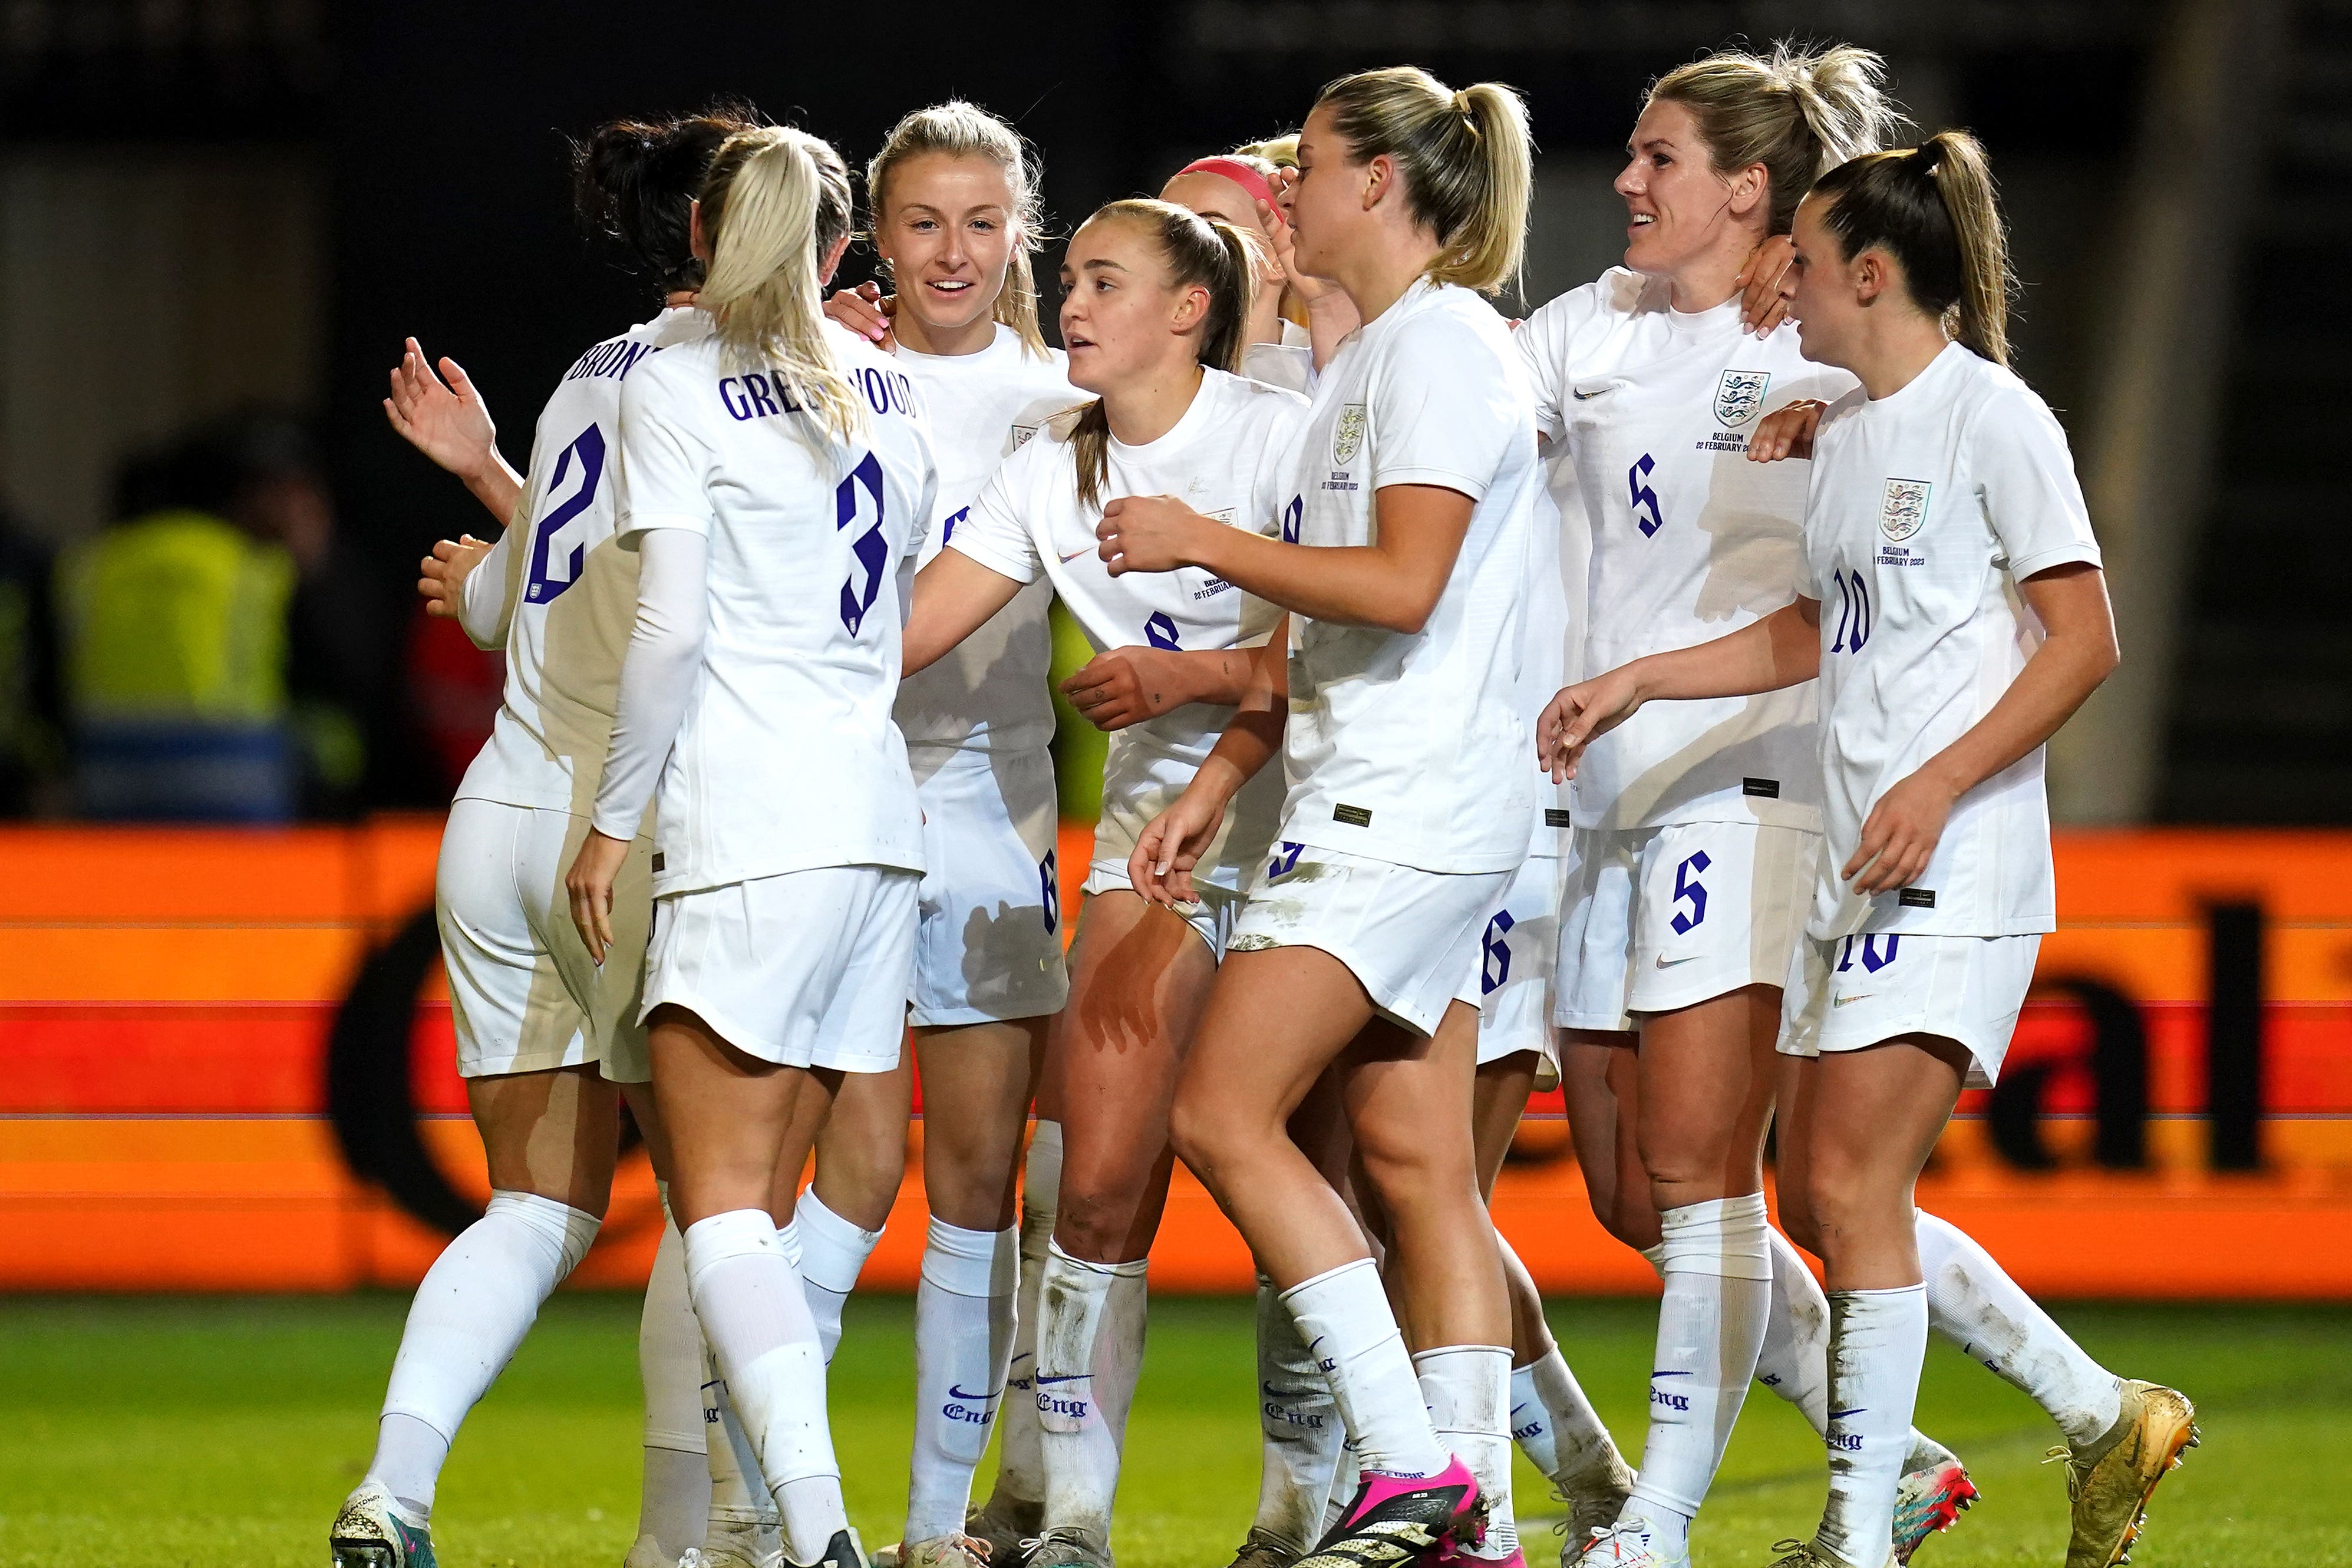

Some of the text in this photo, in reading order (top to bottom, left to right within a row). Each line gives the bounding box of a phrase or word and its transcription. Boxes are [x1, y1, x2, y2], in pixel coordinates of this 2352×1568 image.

[567, 340, 664, 381] BRON
[1696, 441, 1704, 450] 22
[1705, 441, 1741, 452] FEBRUARY
[1713, 432, 1744, 443] BELGIUM
[524, 422, 605, 605] 2
[1629, 453, 1662, 538] 5
[837, 451, 888, 638] 3
[1883, 546, 1909, 556] BELGIUM
[1830, 567, 1869, 655] 10
[1670, 850, 1712, 936] 5
[1036, 1392, 1087, 1418] Eng
[1265, 1402, 1323, 1428] Eng
